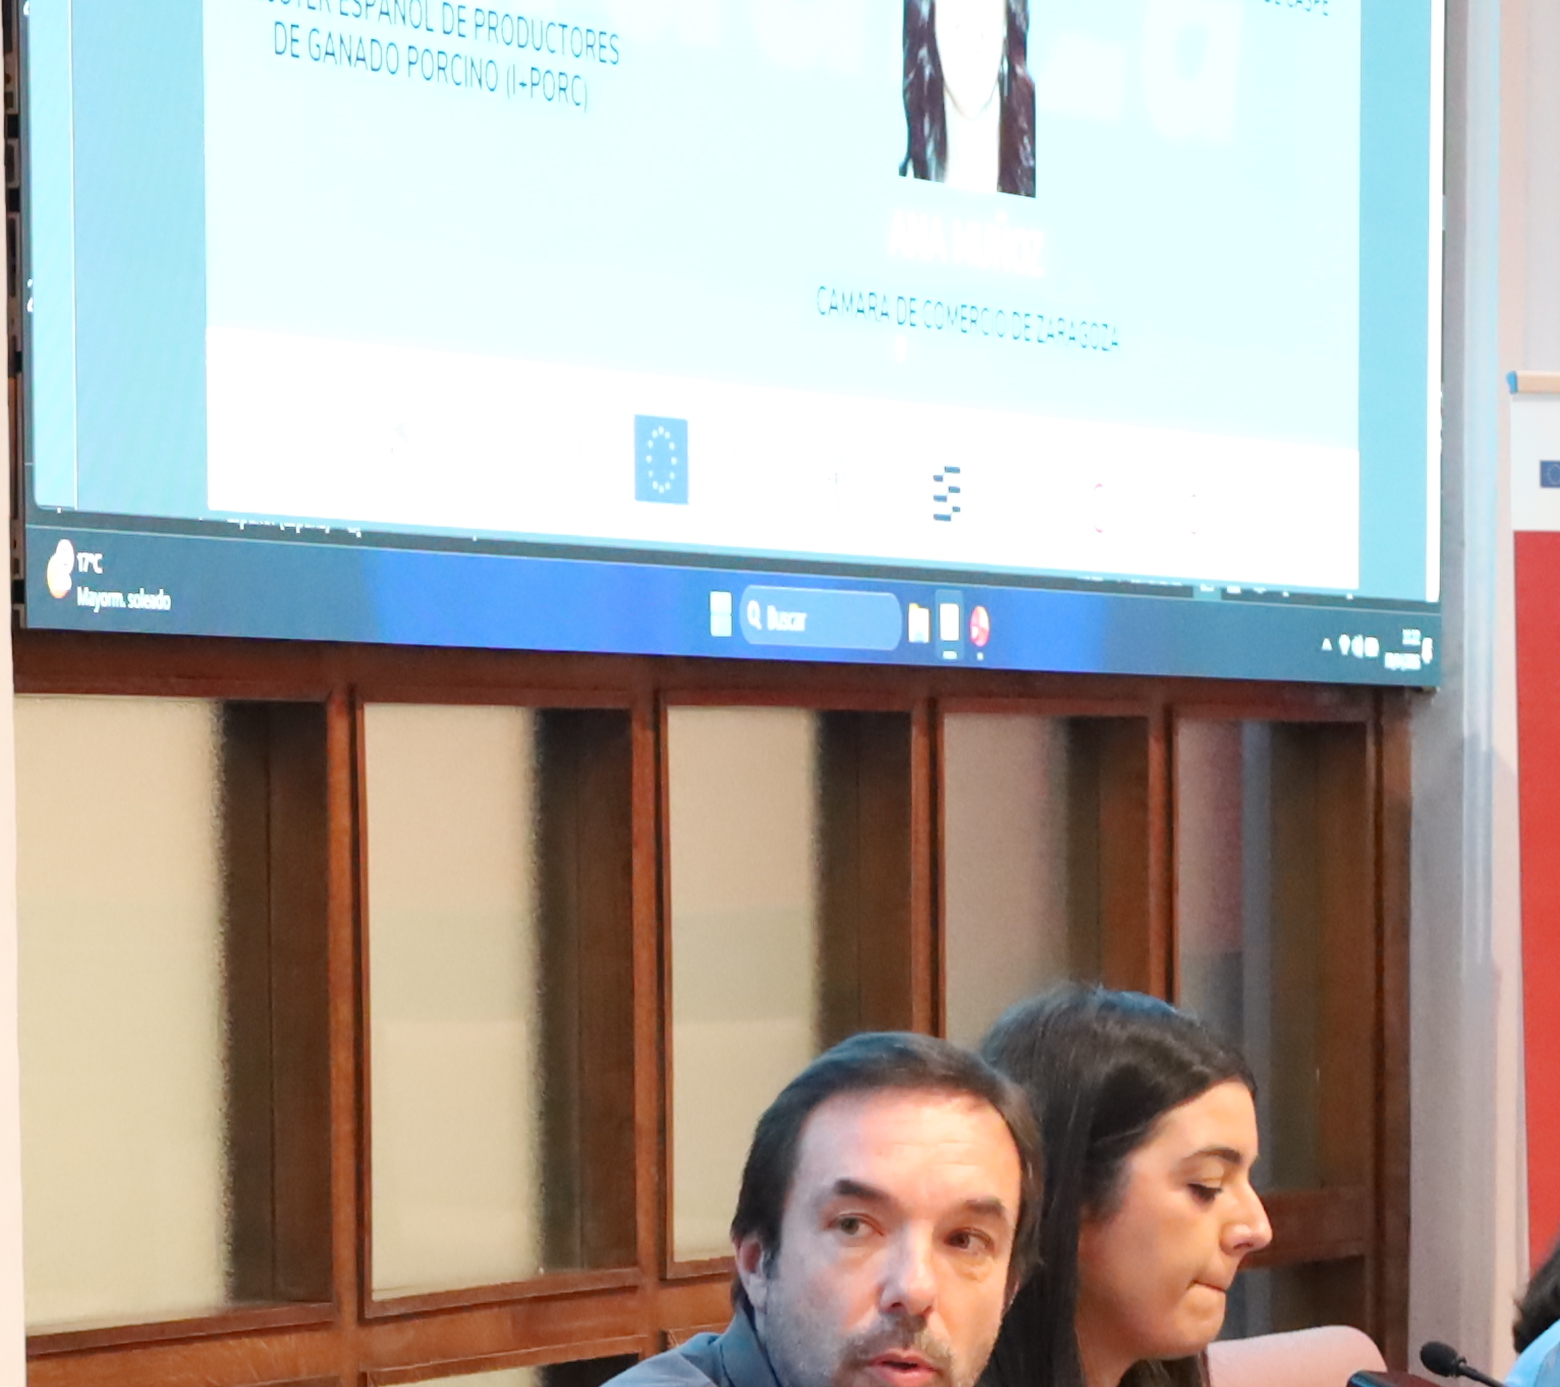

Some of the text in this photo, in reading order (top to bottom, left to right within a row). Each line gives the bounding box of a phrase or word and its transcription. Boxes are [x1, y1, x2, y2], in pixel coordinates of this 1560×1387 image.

[274, 21, 300, 59] DE
[307, 28, 400, 75] GANADO
[407, 45, 499, 92] PORCINO
[442, 2, 467, 38] DE
[474, 8, 620, 65] PRODUCTORES
[896, 296, 917, 327] DE
[1012, 311, 1031, 342] DE
[1037, 314, 1120, 352] ZARAGOZA
[127, 588, 172, 611] soleado
